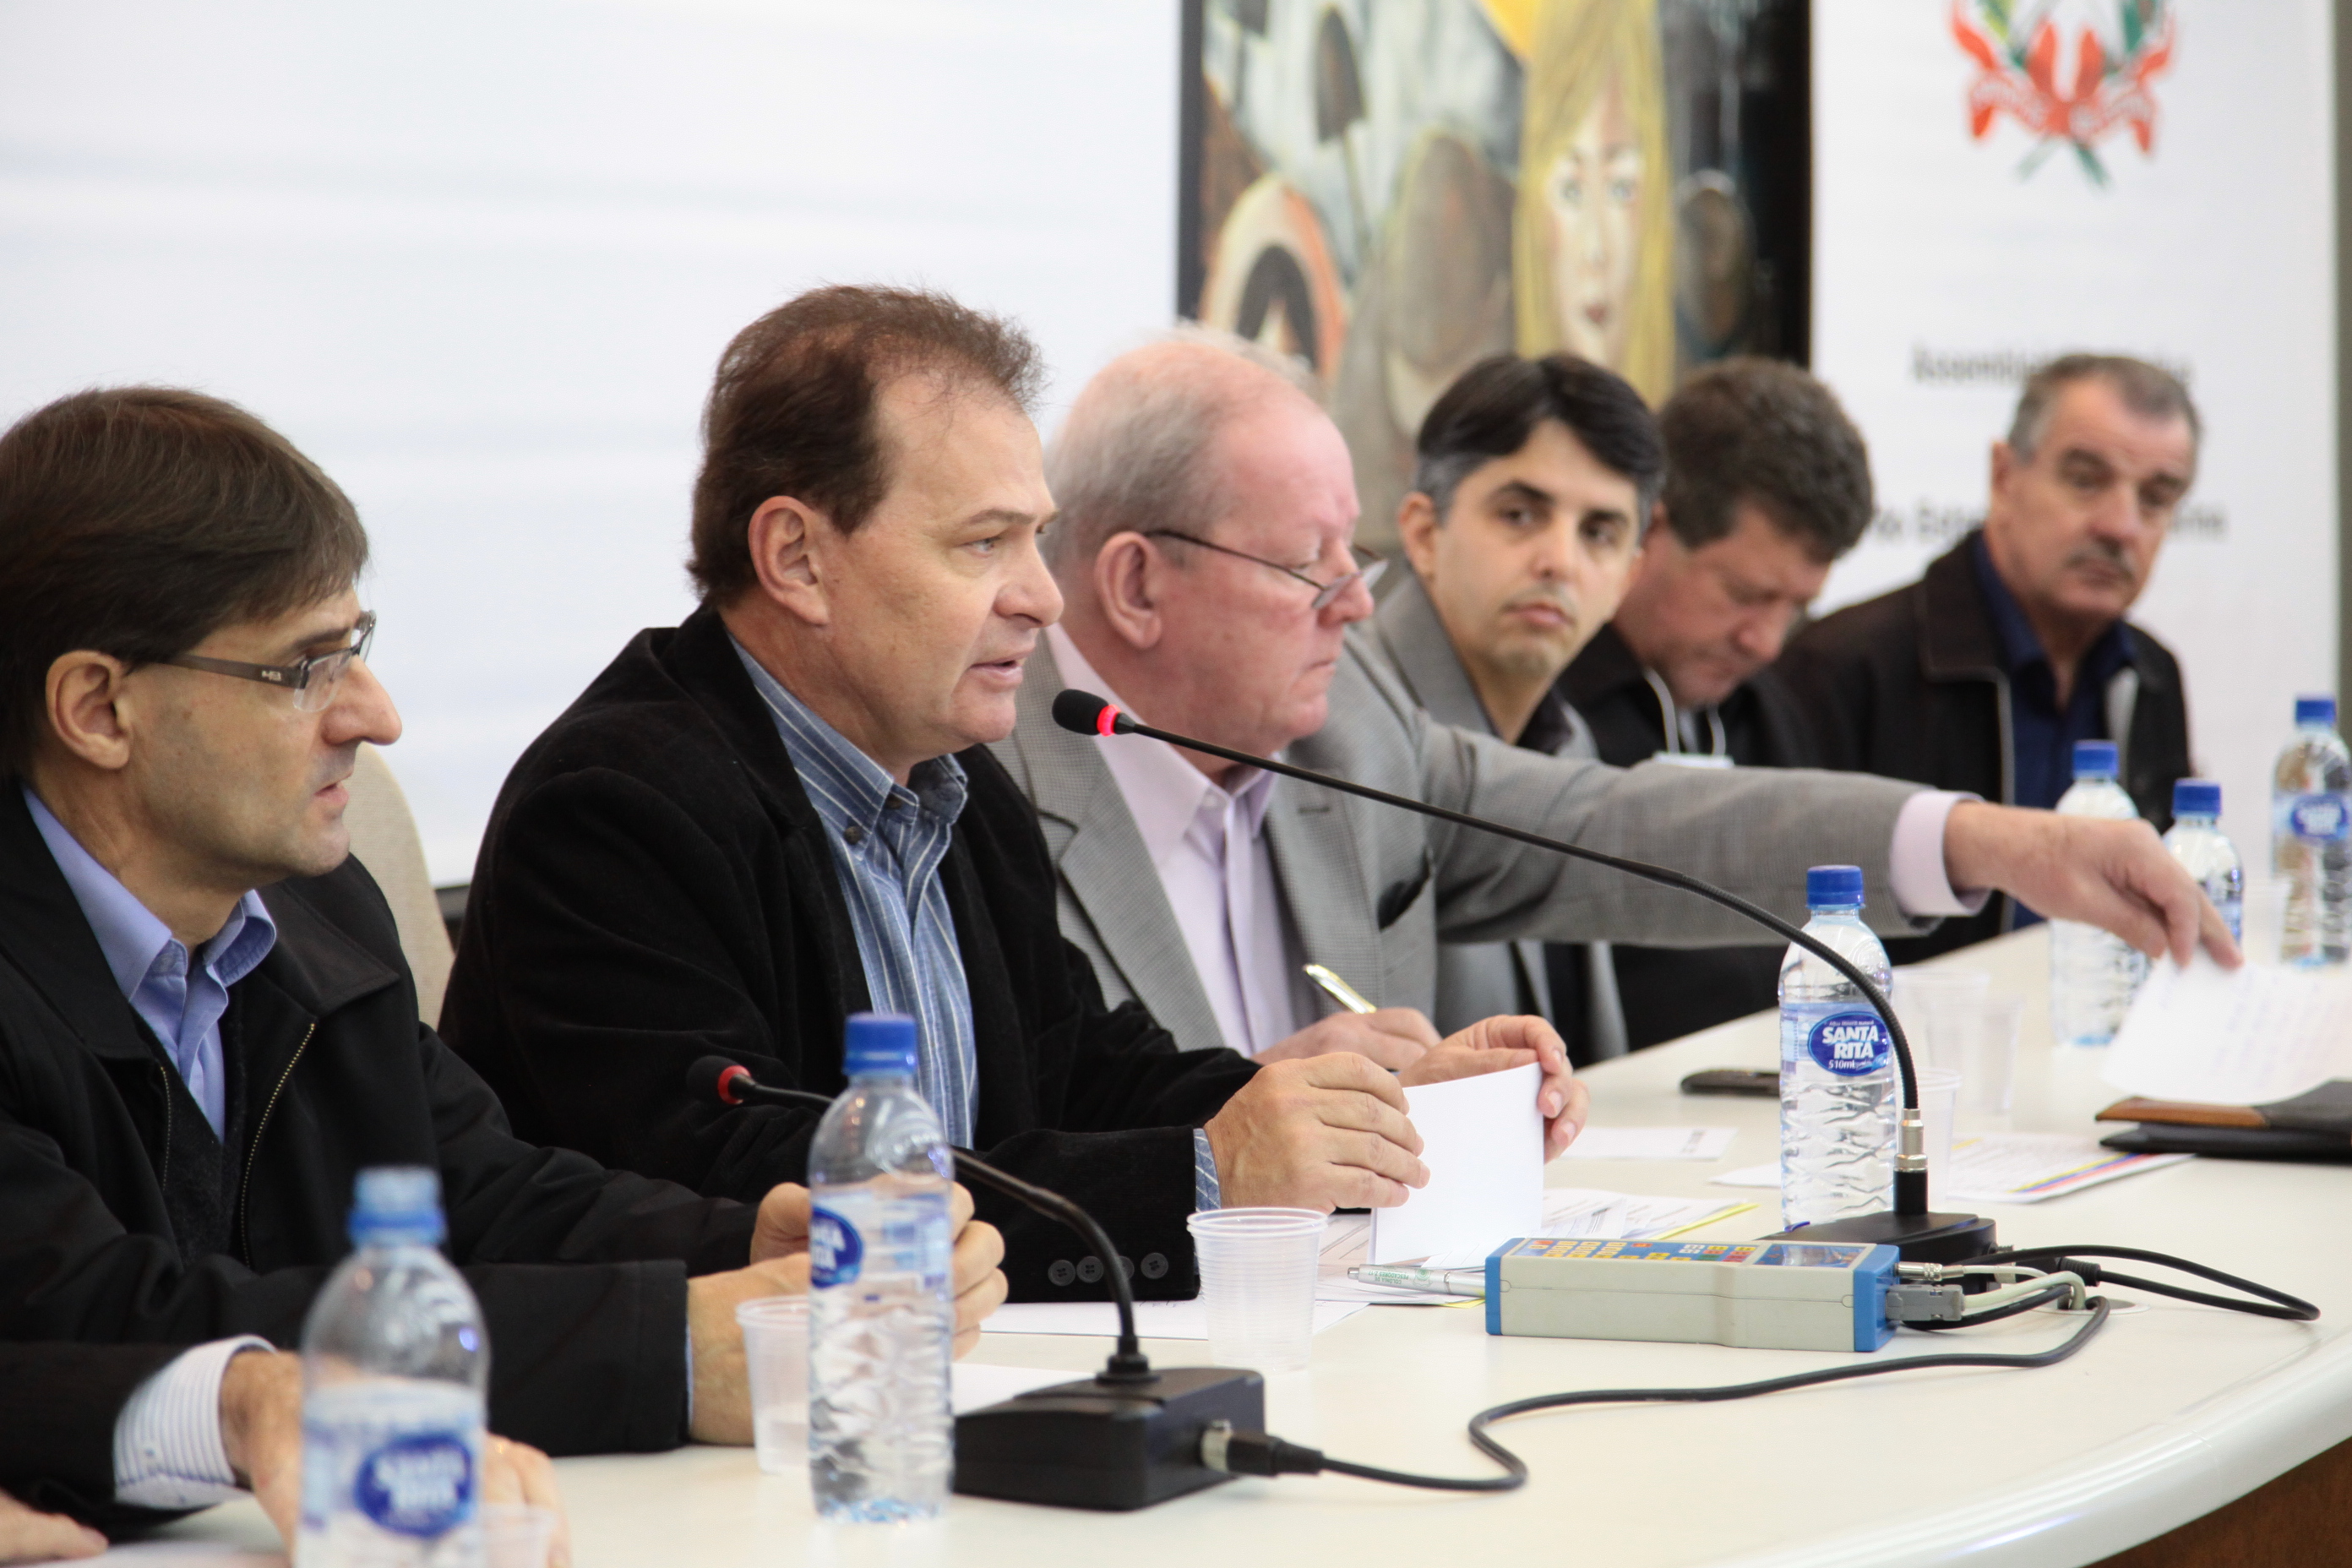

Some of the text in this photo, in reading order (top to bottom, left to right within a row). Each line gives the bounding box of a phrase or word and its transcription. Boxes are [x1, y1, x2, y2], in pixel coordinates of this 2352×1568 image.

[1822, 1025, 1879, 1044] SANTA
[1834, 1041, 1874, 1059] RITA
[1379, 1271, 1409, 1280] PESCADORES
